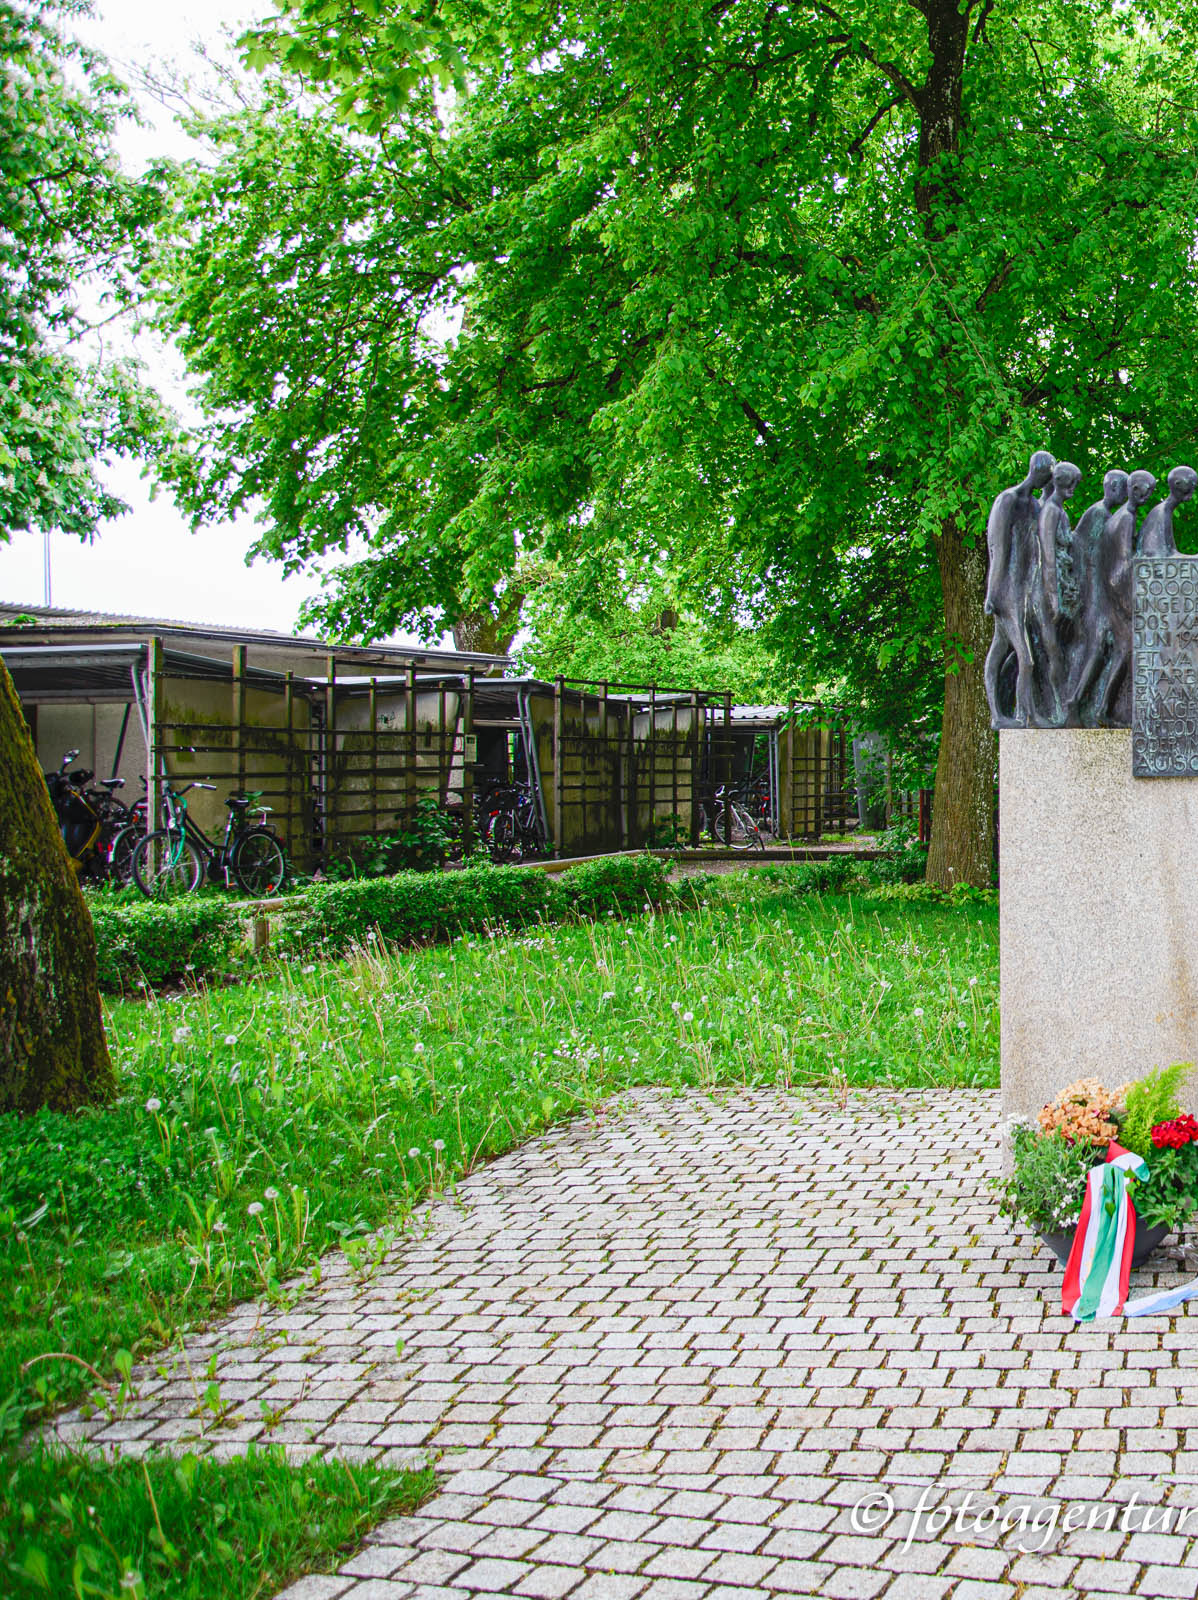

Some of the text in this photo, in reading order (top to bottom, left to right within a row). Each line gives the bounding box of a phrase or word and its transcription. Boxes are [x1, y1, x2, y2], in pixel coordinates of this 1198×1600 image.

[1134, 597, 1181, 614] LINGE
[1134, 614, 1170, 631] DOS
[1134, 631, 1171, 649] JUNI
[1136, 650, 1192, 667] ETWA
[1133, 719, 1161, 736] AUF
[1133, 736, 1181, 754] ODER
